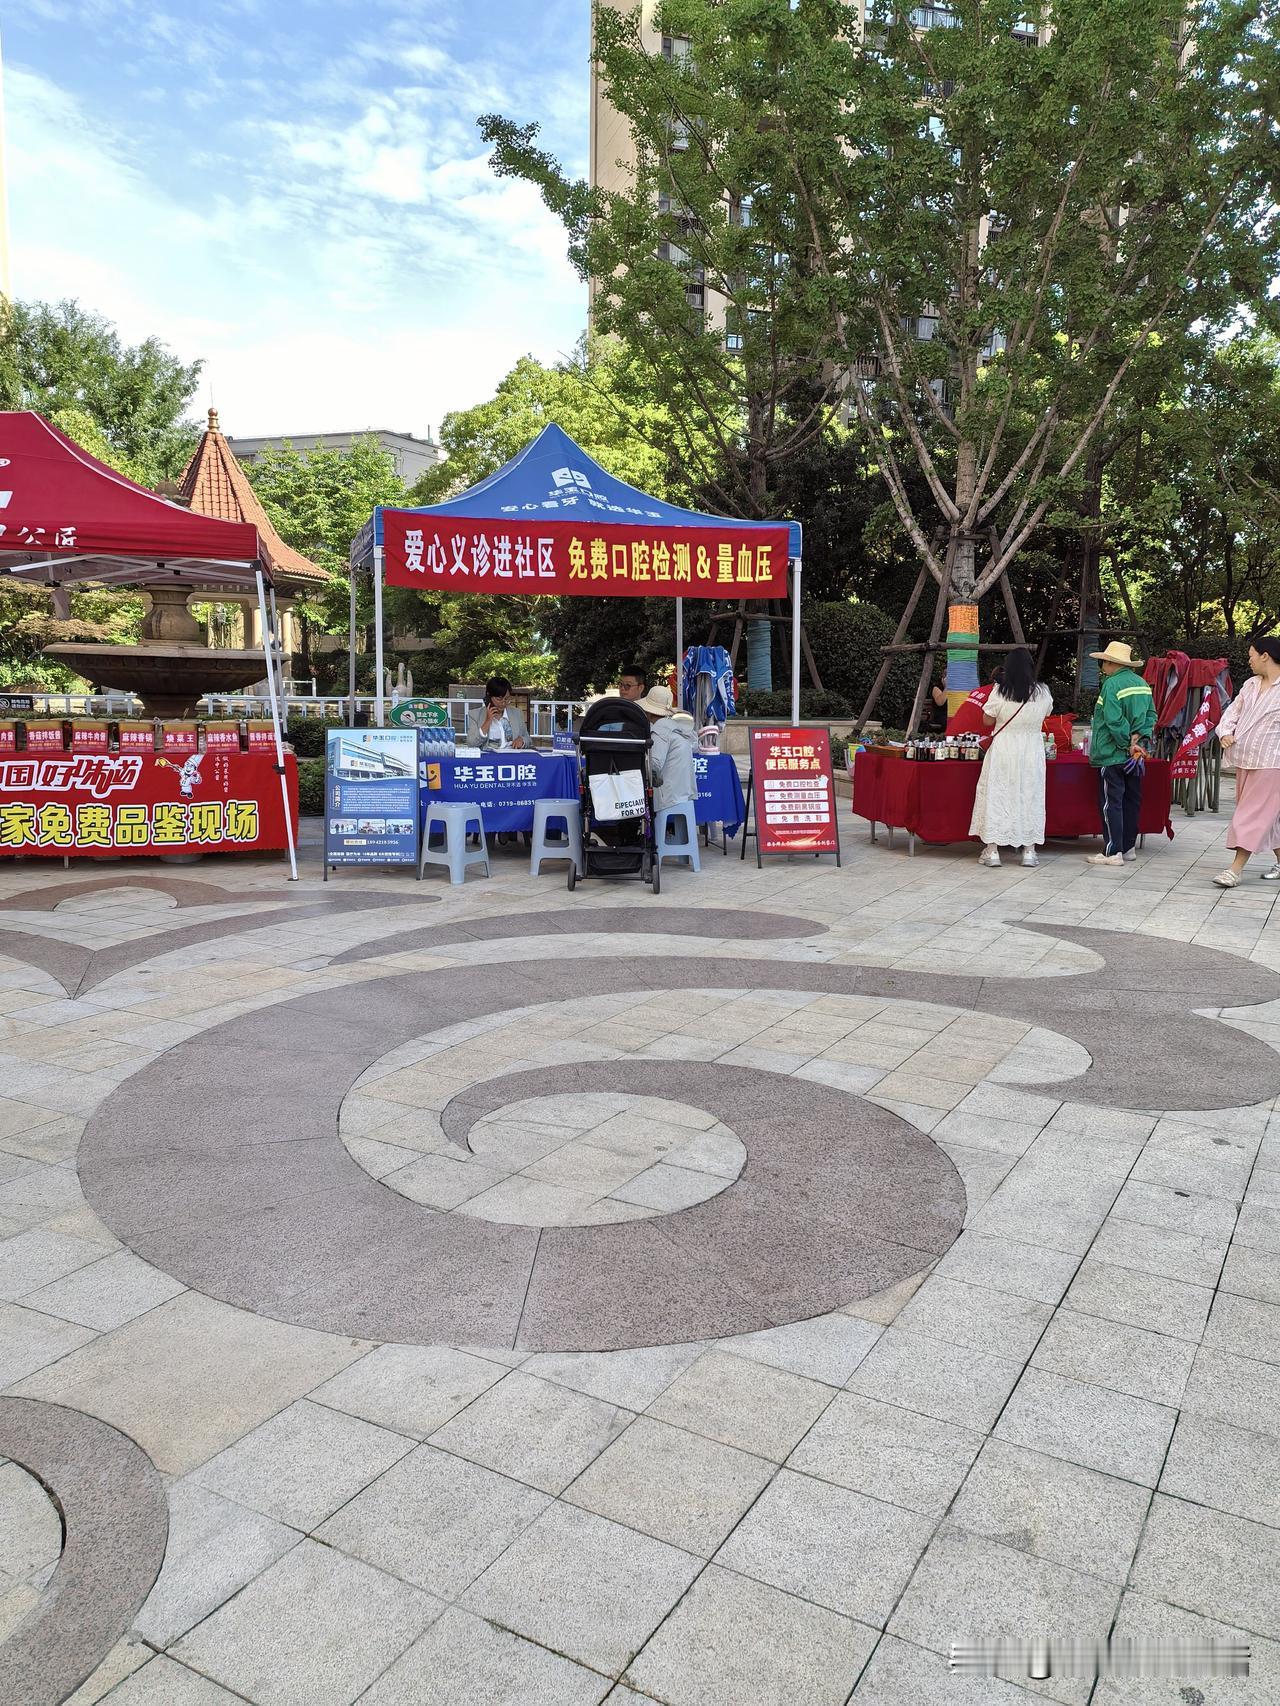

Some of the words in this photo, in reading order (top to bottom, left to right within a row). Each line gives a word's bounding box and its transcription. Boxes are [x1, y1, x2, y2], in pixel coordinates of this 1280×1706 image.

[404, 529, 557, 579] 爱心义诊进社区
[74, 731, 106, 741] 麻辣牛肉酱
[770, 745, 814, 758] 华玉口腔
[765, 758, 821, 771] 便民服务点
[0, 755, 143, 798] 国好味道
[454, 764, 537, 782] 华玉口腔
[779, 780, 820, 788] 免费口腔检查
[621, 809, 634, 817] FOR
[0, 802, 259, 848] 家免费品鉴现场
